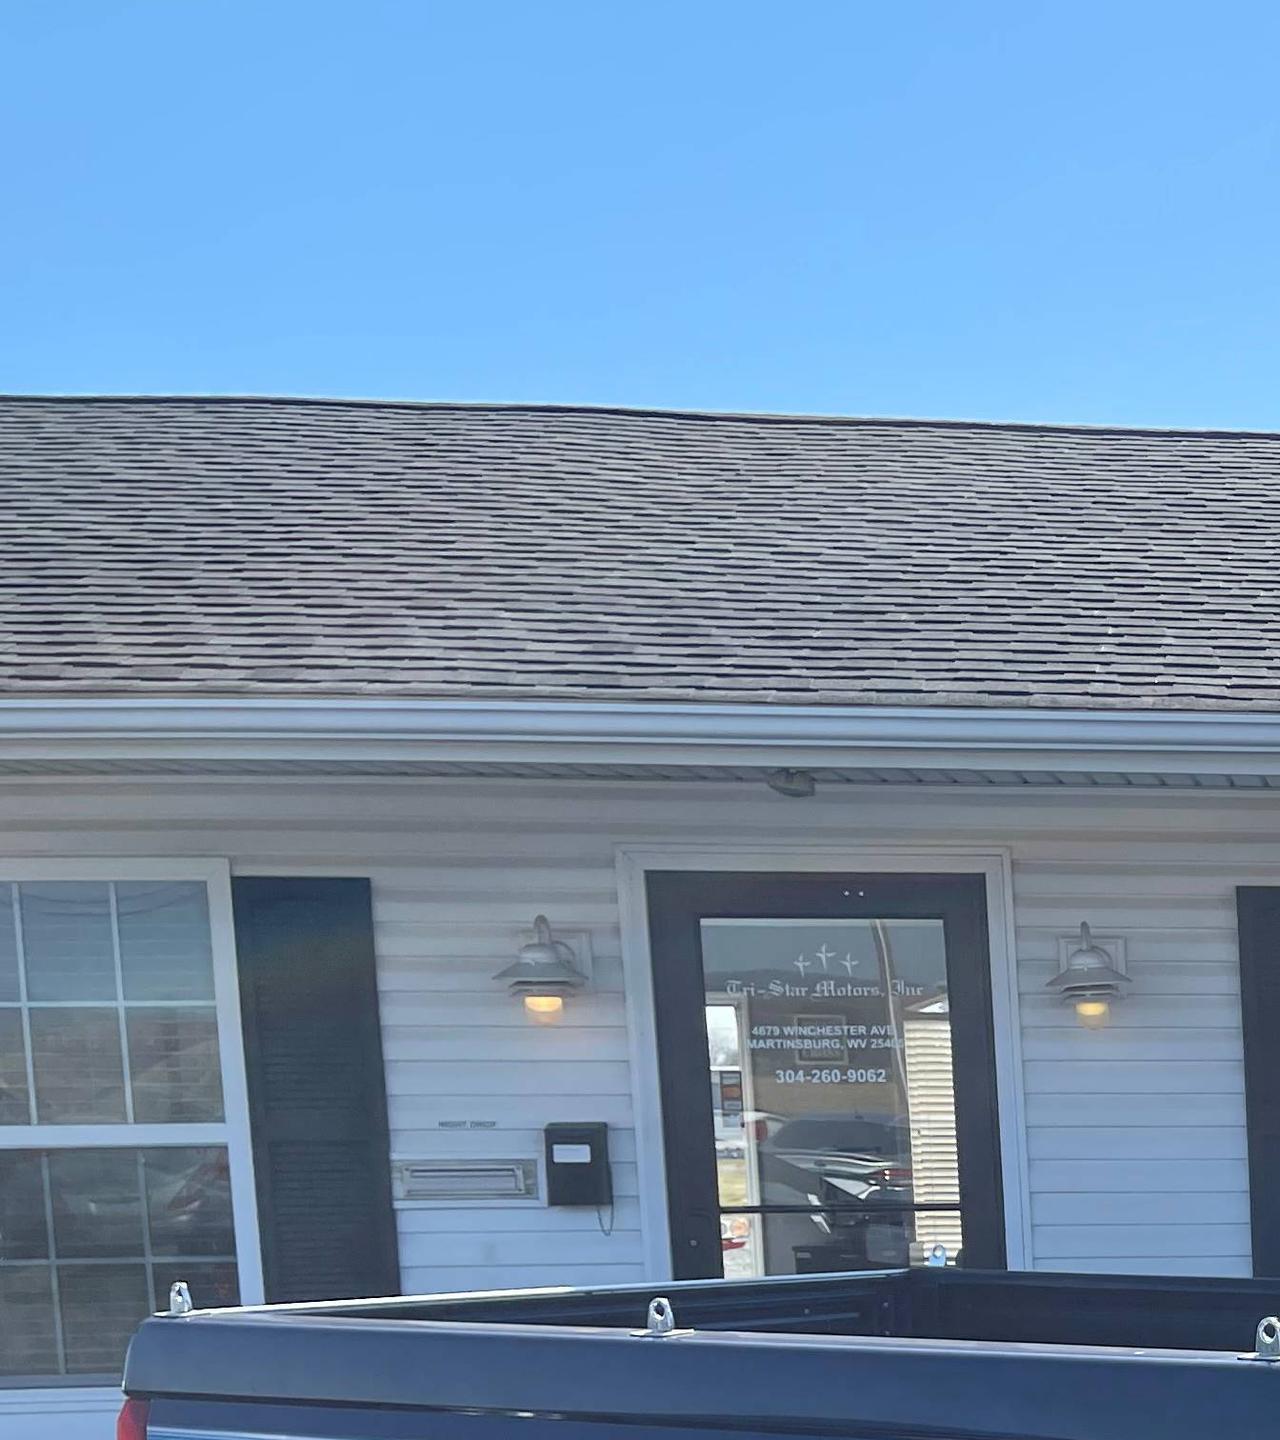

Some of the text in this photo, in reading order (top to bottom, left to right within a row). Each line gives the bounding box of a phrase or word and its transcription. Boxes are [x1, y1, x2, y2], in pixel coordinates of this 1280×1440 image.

[726, 979, 808, 997] Tri-Star
[811, 980, 885, 998] Motors,
[783, 1025, 866, 1036] WINCHESTER
[747, 1038, 844, 1050] MARTINSBURG,
[847, 1038, 867, 1049] WV
[775, 1069, 887, 1084] 304-260-9062
